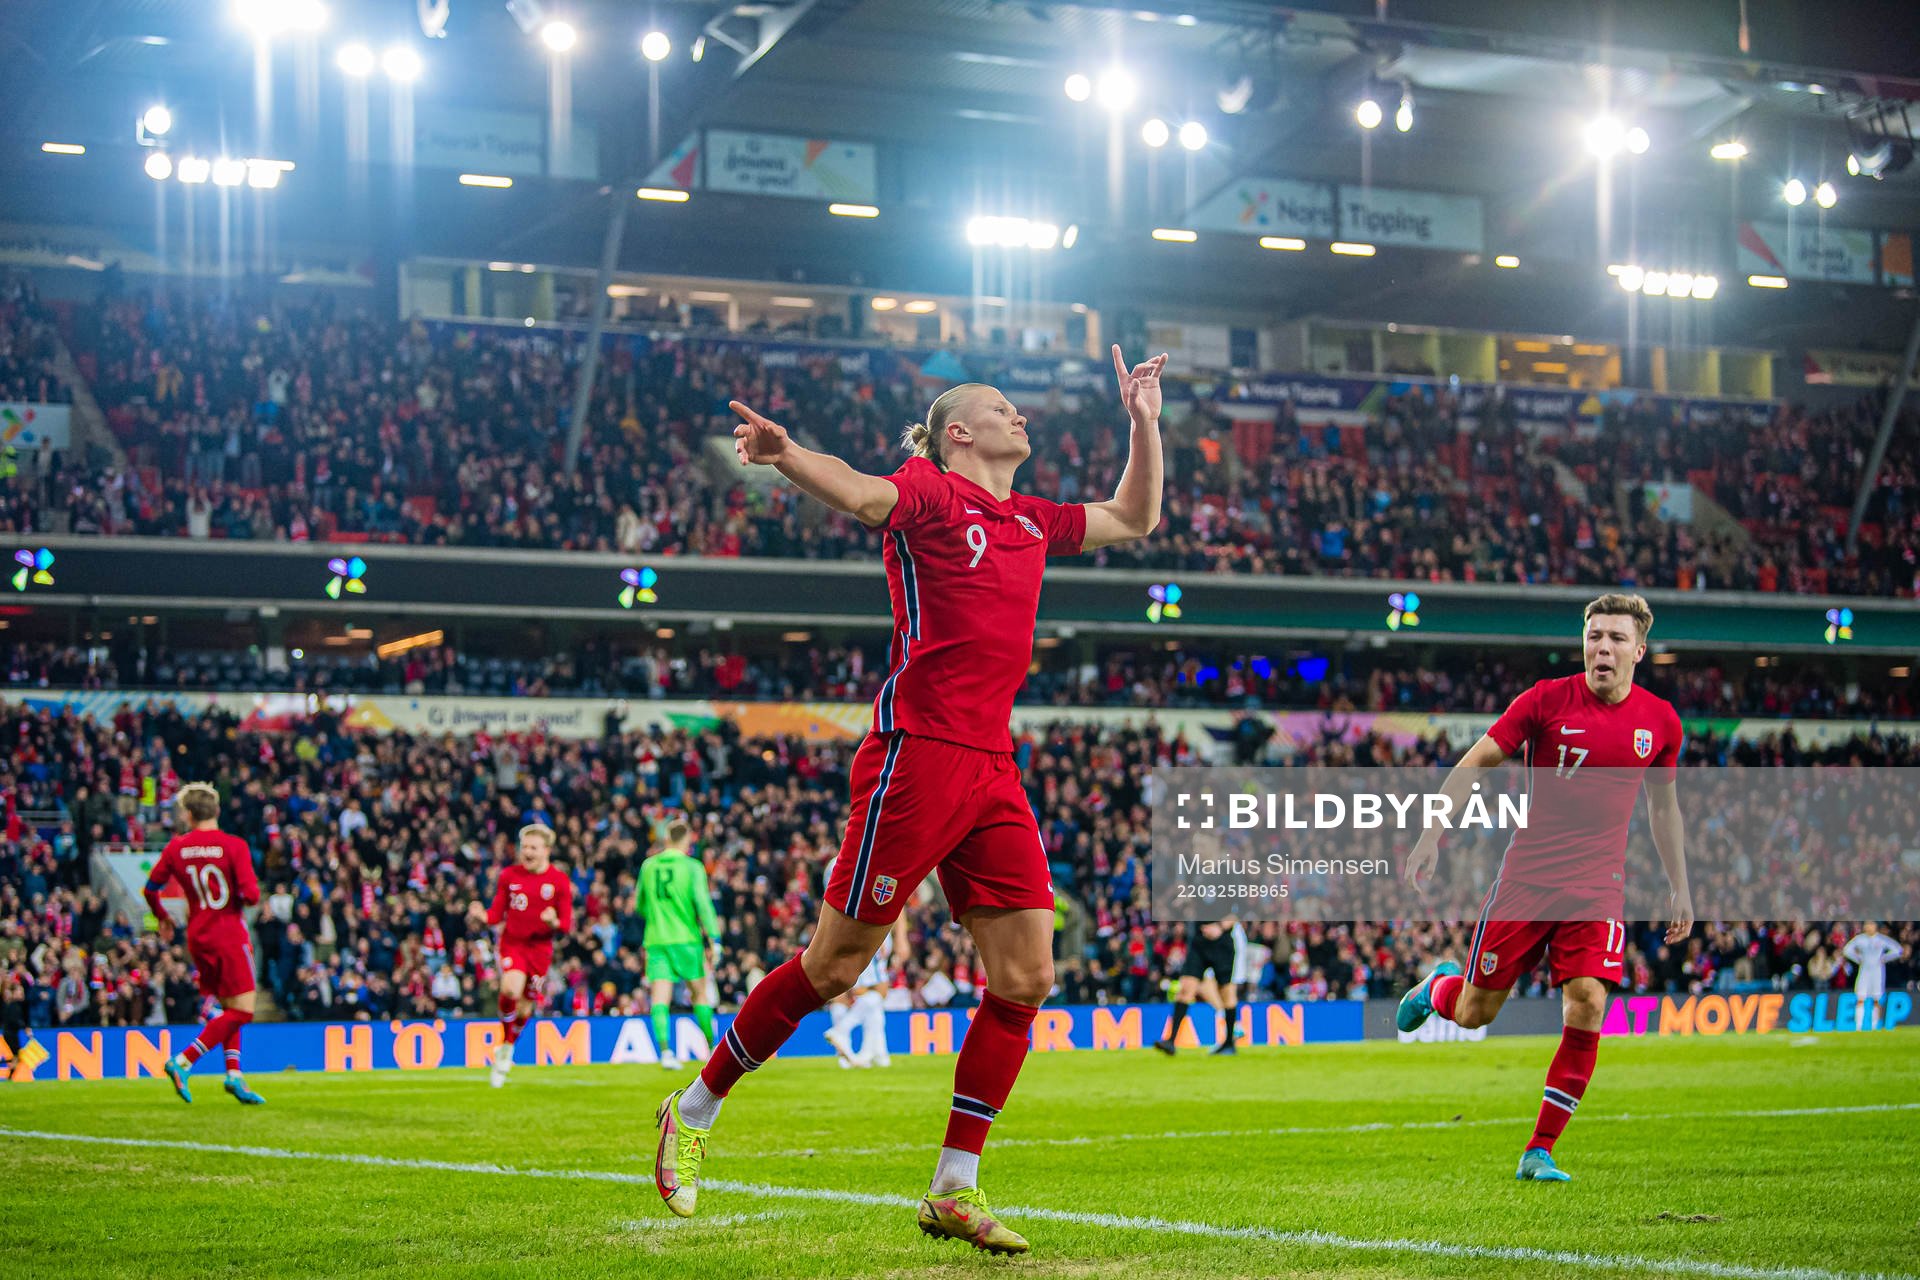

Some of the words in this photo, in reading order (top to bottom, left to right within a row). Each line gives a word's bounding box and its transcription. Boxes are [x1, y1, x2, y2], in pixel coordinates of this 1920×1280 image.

[1278, 198, 1334, 226] Nors
[1348, 202, 1432, 239] Tipping
[966, 523, 988, 568] 9
[1555, 743, 1589, 780] 17
[185, 863, 230, 911] 10
[1606, 917, 1625, 954] 17
[1599, 996, 1658, 1037] AT
[1659, 993, 1785, 1037] MOVE
